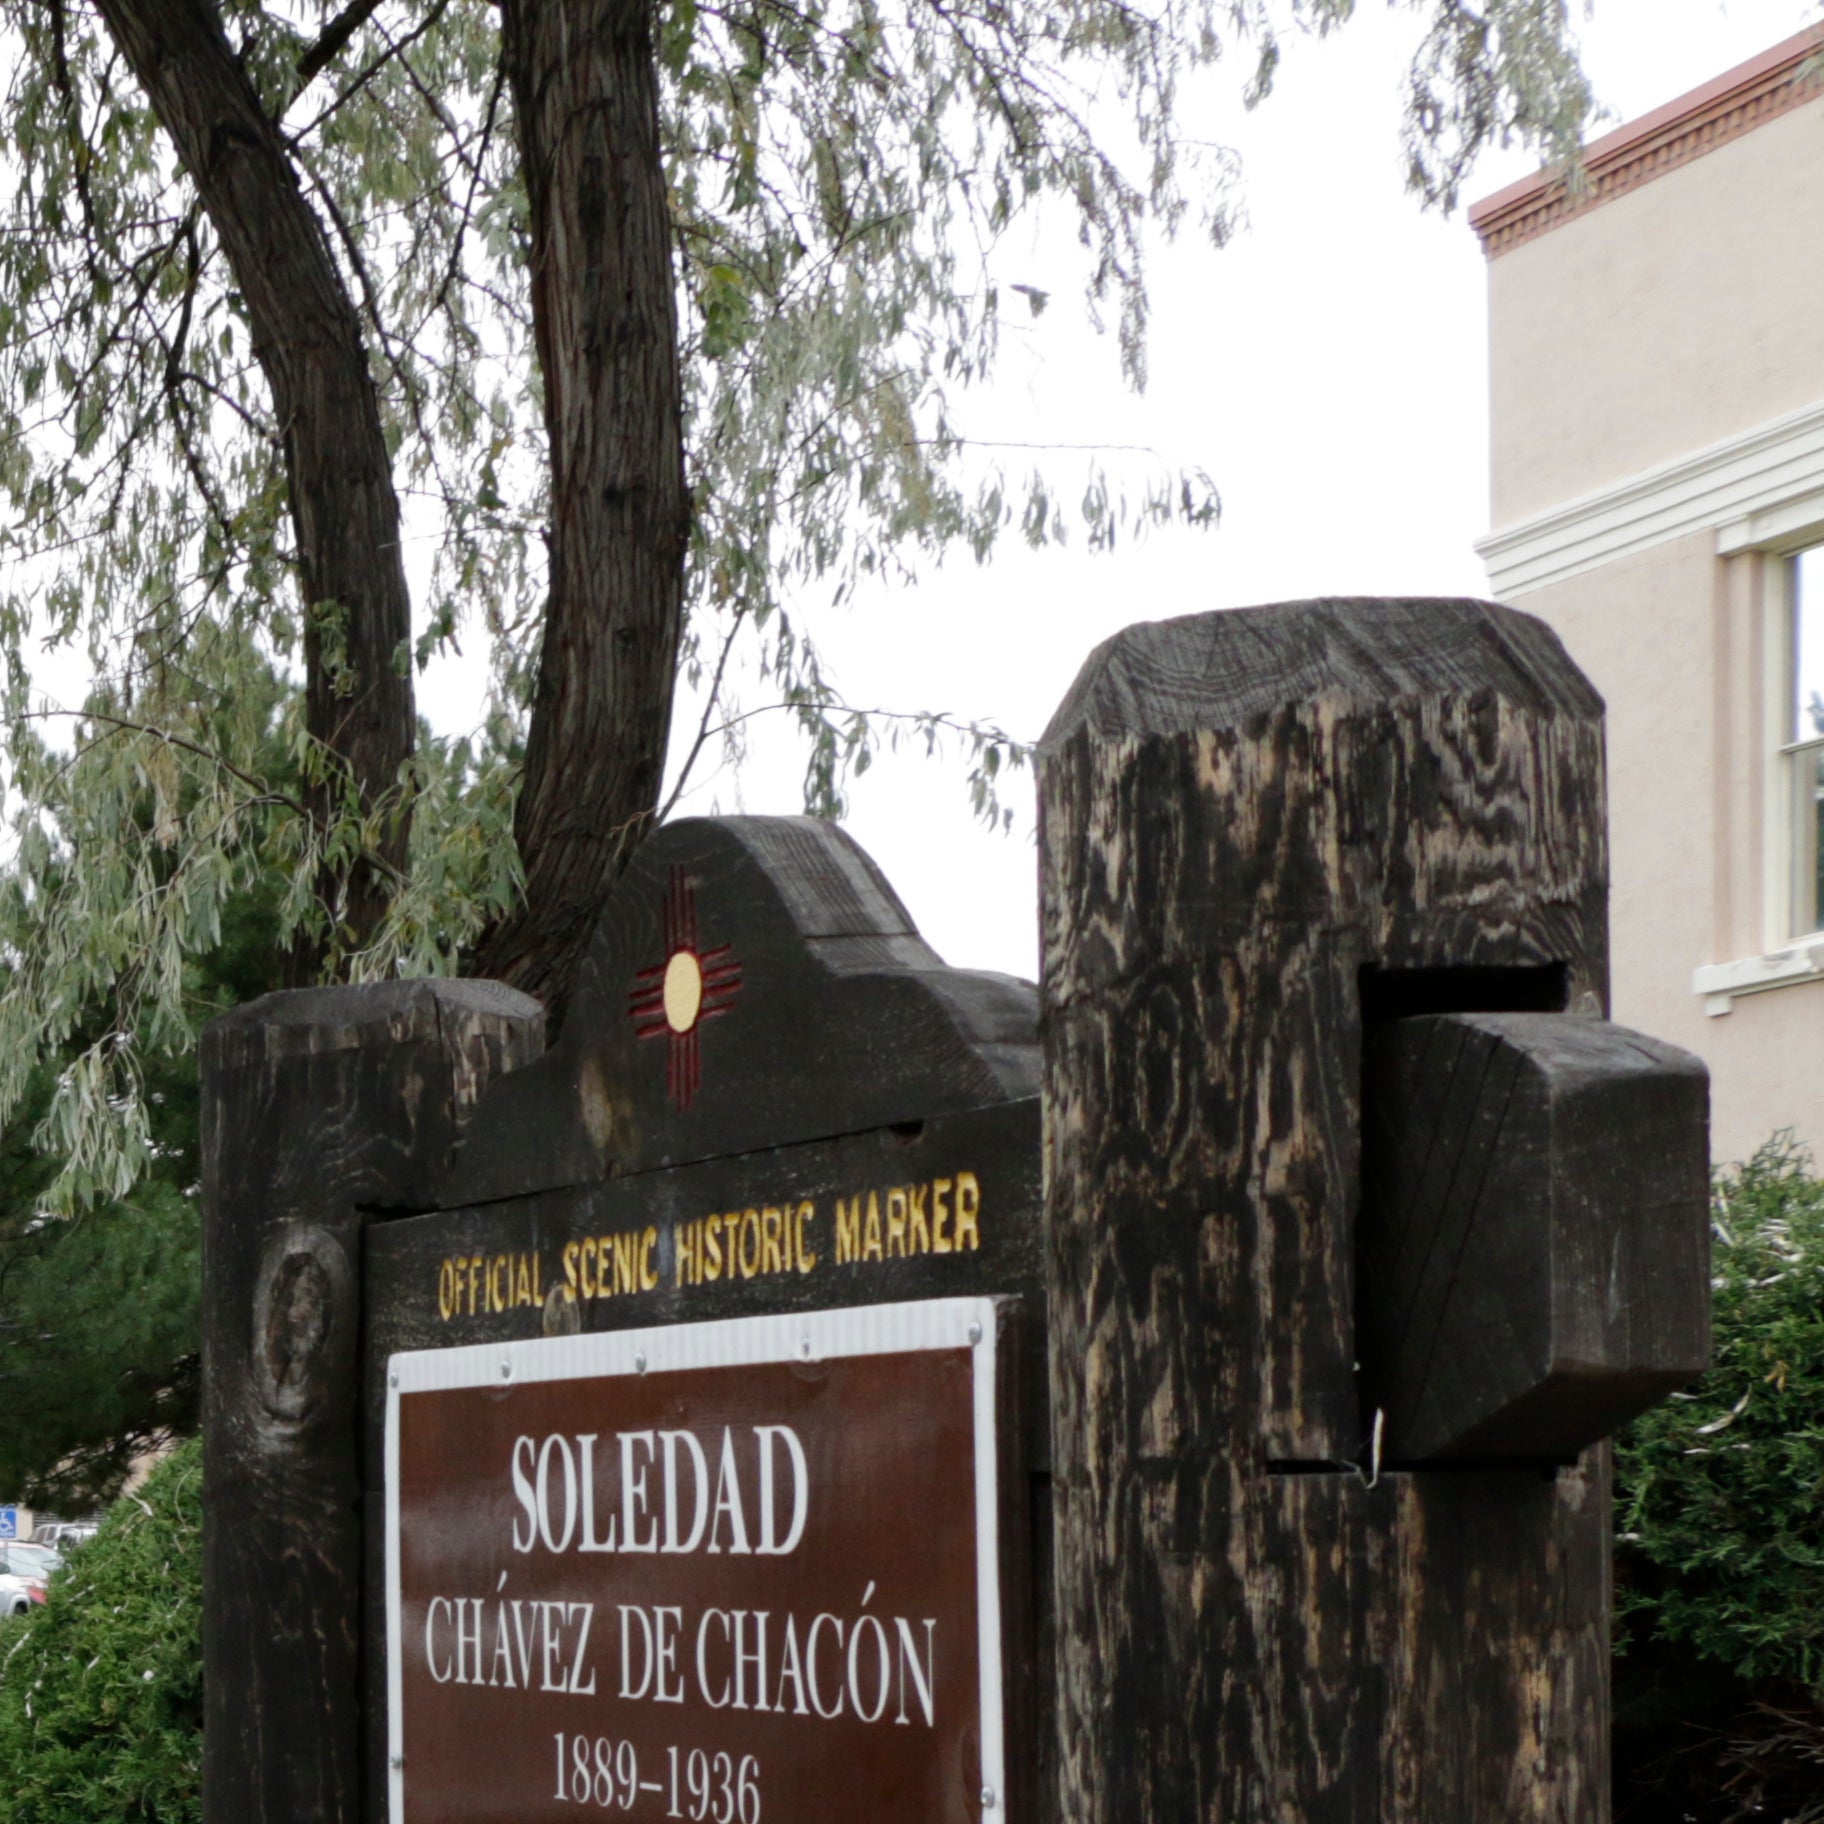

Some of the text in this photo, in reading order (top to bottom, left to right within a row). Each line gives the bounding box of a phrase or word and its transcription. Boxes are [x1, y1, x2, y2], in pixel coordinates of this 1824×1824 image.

[438, 1171, 981, 1322] OFFICIAL SCENIC HISTORIC MARKER
[511, 1424, 808, 1555] SOLEDAD
[424, 1569, 937, 1727] CHÁVEZ DE CHACÓN
